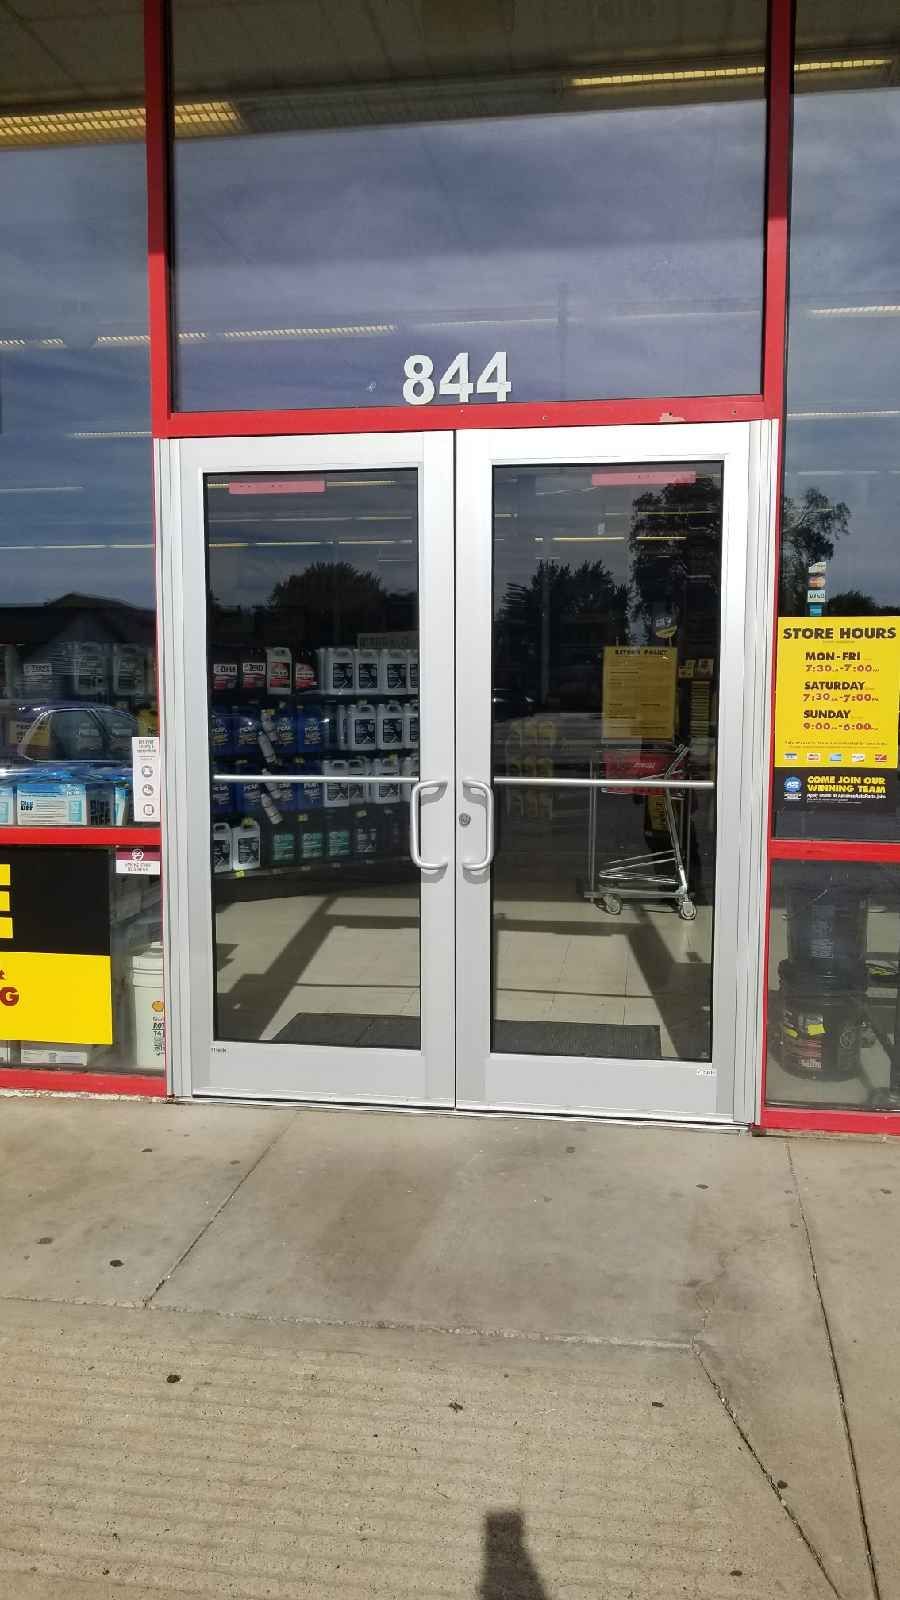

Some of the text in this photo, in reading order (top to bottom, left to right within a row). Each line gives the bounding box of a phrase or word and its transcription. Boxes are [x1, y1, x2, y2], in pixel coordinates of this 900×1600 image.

[402, 351, 512, 405] 844
[783, 627, 897, 640] STORE HOURS
[804, 681, 865, 690] SATURDAY
[803, 710, 851, 719] SUNDAY
[807, 775, 886, 785] COME JOIN OUR
[857, 785, 886, 793] TEAM
